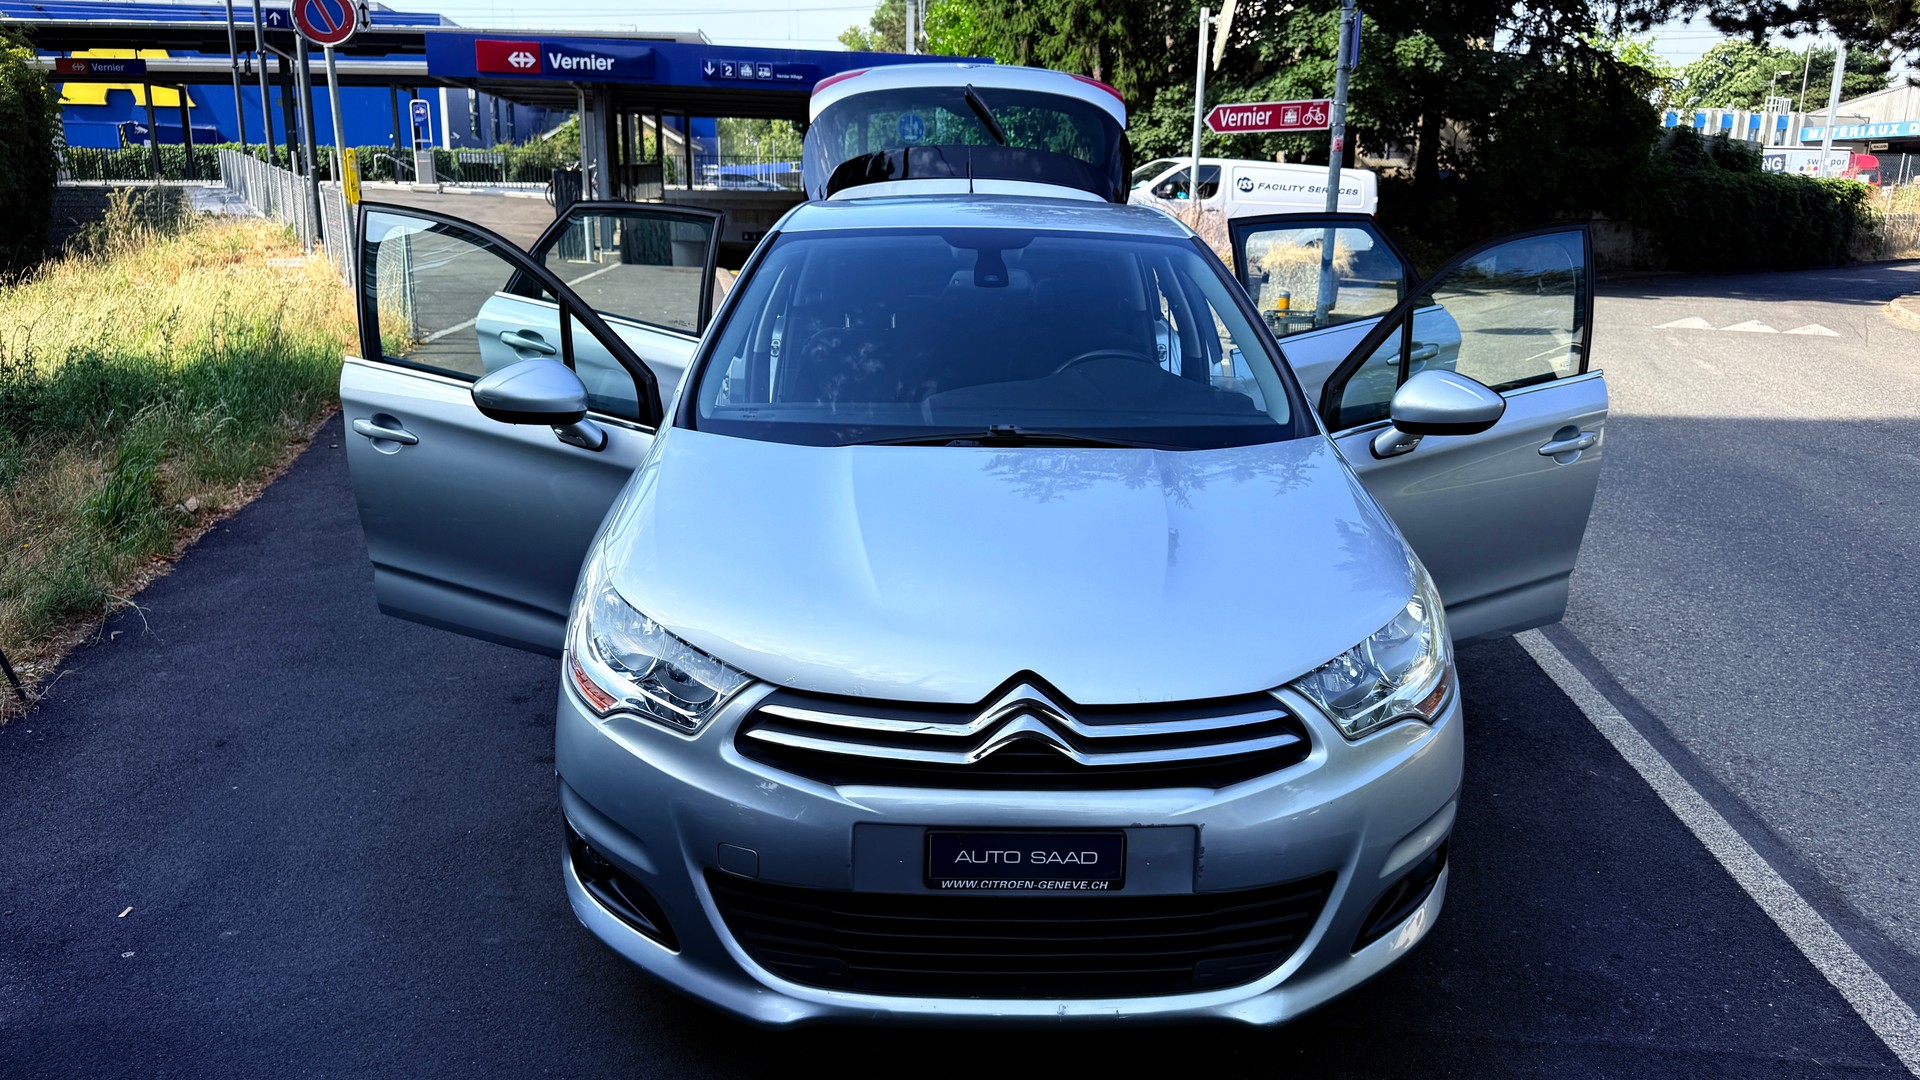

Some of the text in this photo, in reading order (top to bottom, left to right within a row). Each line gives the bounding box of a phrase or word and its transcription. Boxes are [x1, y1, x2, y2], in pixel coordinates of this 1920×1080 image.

[91, 62, 125, 72] Vernier
[548, 52, 615, 71] Vernier
[725, 65, 733, 77] 2
[1219, 107, 1272, 127] Vernier
[1257, 182, 1359, 196] FACILITY SERCES
[954, 850, 1098, 865] AUTO SAAD
[941, 880, 1109, 890] WWW.CITROEN-GENEVE.CH
